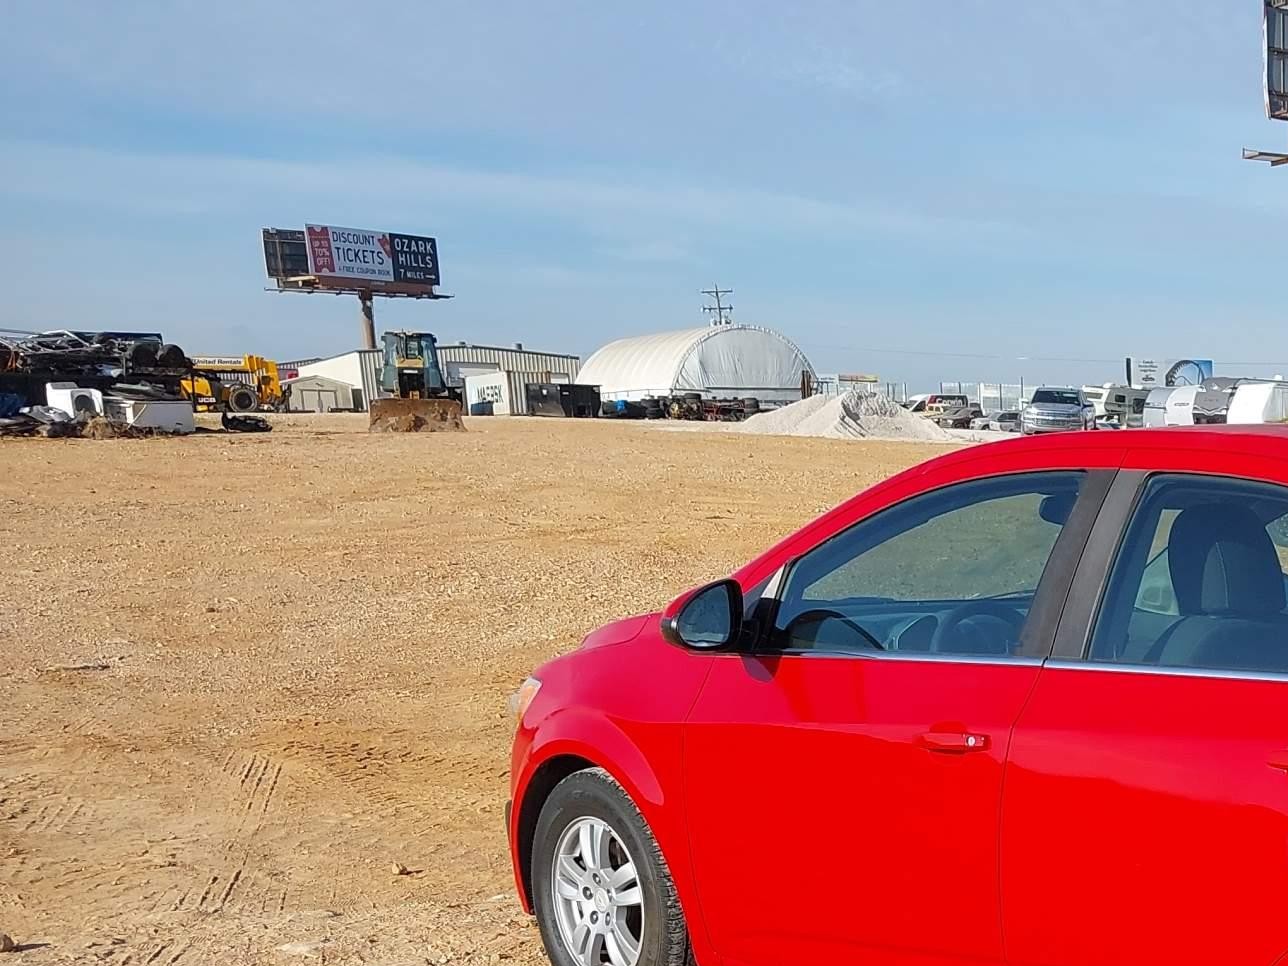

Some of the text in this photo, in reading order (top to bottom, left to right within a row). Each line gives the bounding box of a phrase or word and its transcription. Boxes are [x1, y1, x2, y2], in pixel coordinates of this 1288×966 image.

[332, 231, 375, 247] DISCOUNT
[394, 238, 434, 254] OZARK
[335, 247, 385, 266] TICKETS
[398, 252, 433, 268] HILLS
[399, 269, 424, 280] 7 MILES
[195, 358, 242, 366] United Rentals
